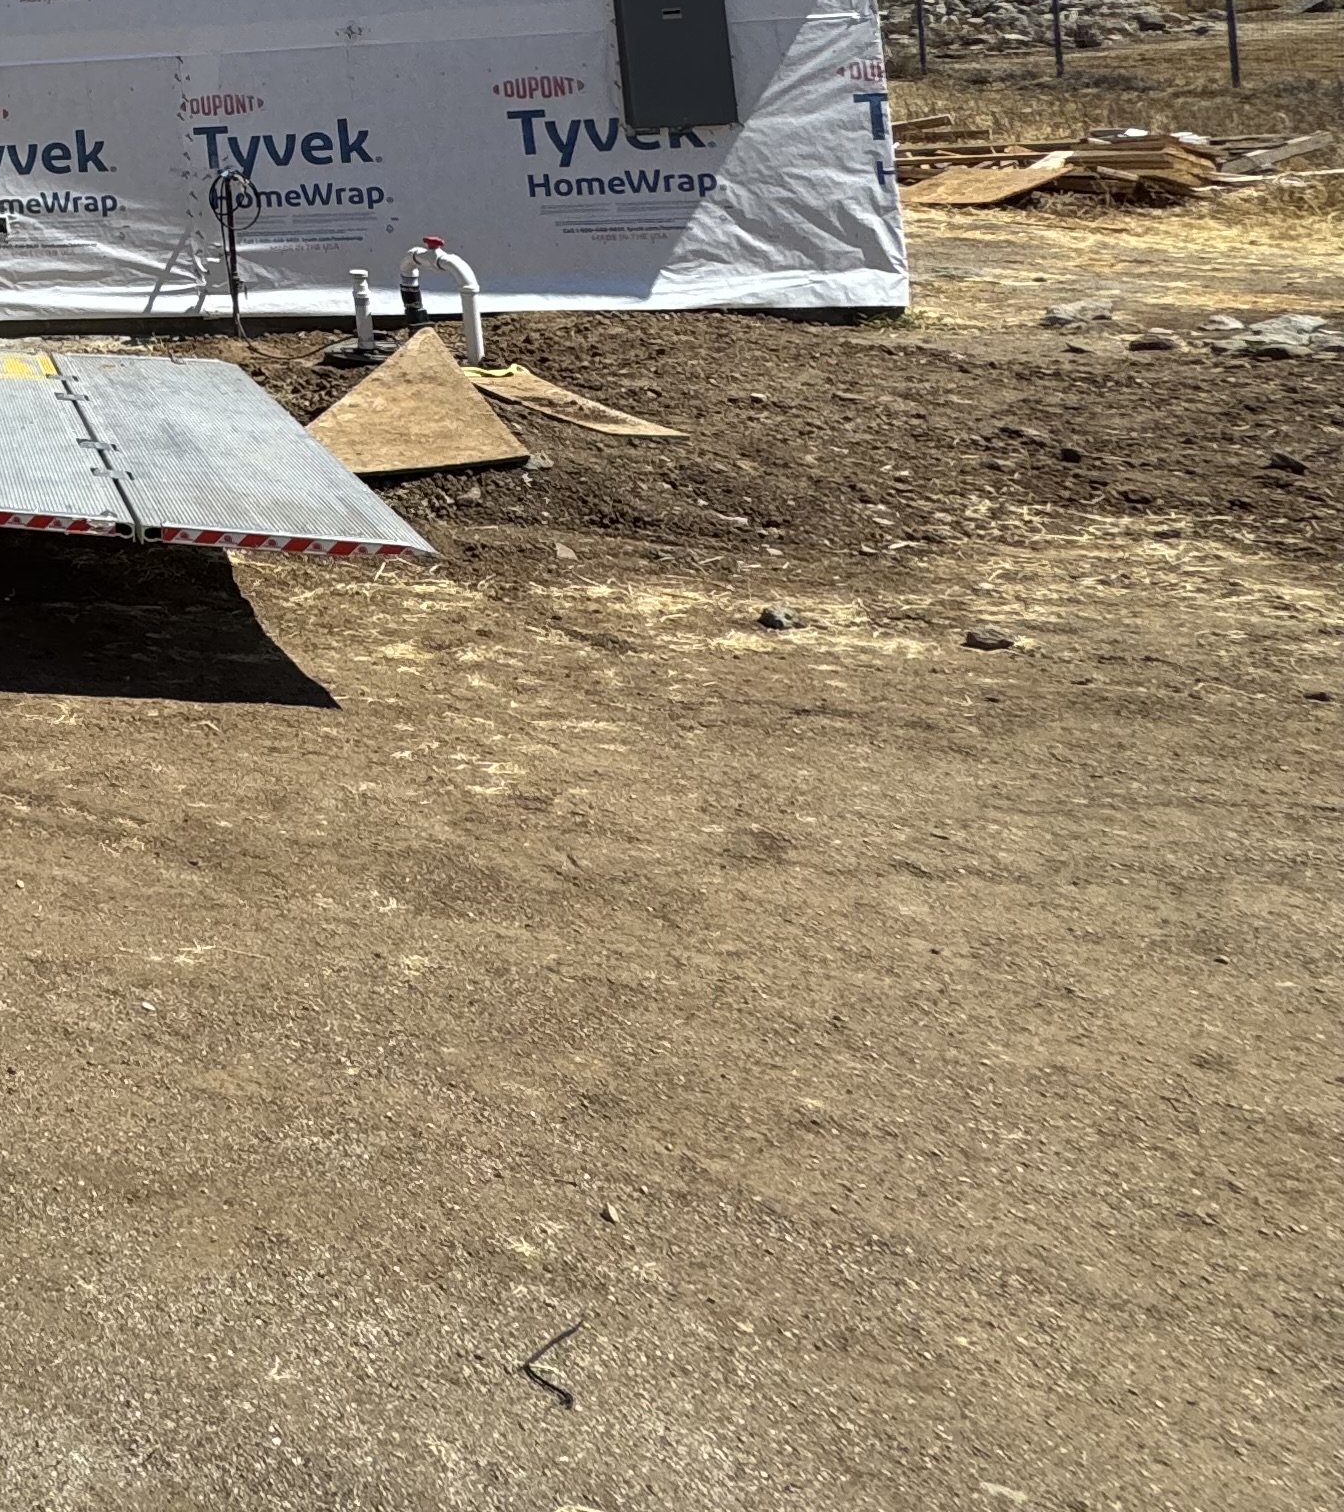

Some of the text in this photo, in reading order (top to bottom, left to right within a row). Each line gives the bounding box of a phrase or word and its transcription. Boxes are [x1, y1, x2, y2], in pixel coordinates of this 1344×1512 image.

[503, 76, 574, 100] DUPONT
[190, 94, 255, 117] DUPONT
[193, 118, 375, 180] Tyvek
[527, 169, 717, 198] HomeWrap
